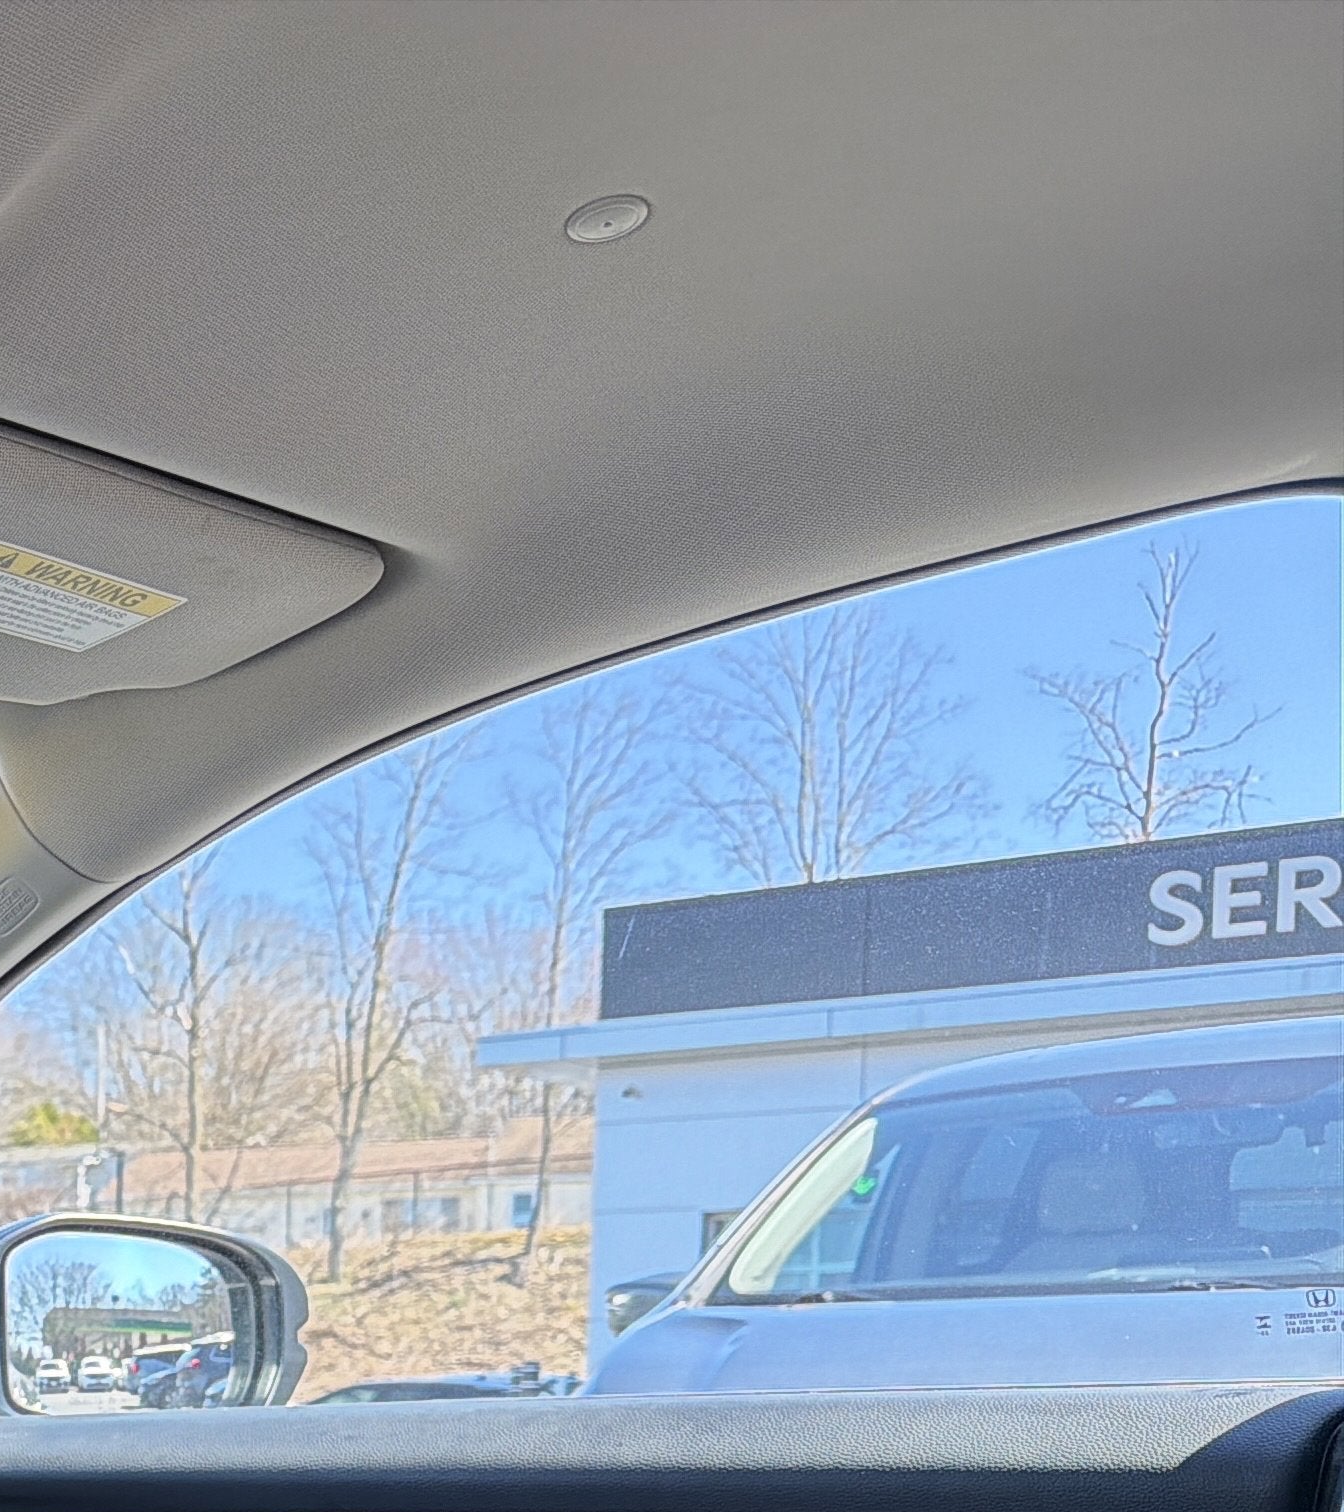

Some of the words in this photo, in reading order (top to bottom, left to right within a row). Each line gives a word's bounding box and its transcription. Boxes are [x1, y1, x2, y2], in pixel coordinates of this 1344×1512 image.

[18, 583, 80, 605] ADVANCED
[75, 601, 98, 611] AIR
[93, 606, 128, 620] BAGS
[25, 561, 148, 607] WARNING
[1147, 855, 1344, 946] SER
